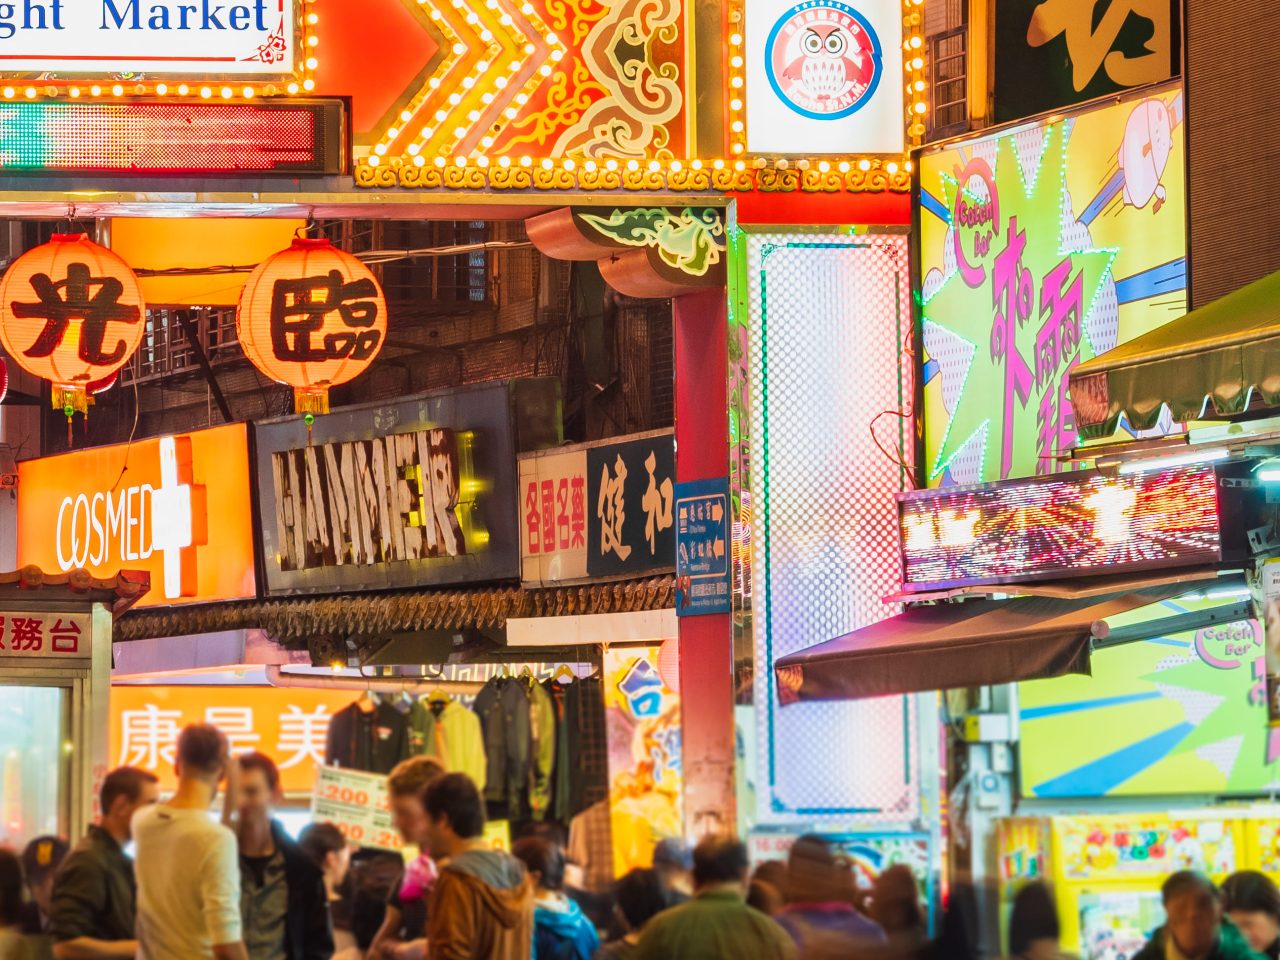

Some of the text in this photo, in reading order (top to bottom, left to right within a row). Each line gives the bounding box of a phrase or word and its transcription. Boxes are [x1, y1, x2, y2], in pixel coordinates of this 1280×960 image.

[11, 263, 141, 365] 光
[270, 269, 388, 363] 臨
[56, 483, 154, 571] COSMED
[526, 474, 585, 554] 各國名藥
[598, 450, 673, 561] 健和
[118, 705, 332, 771] 康是美
